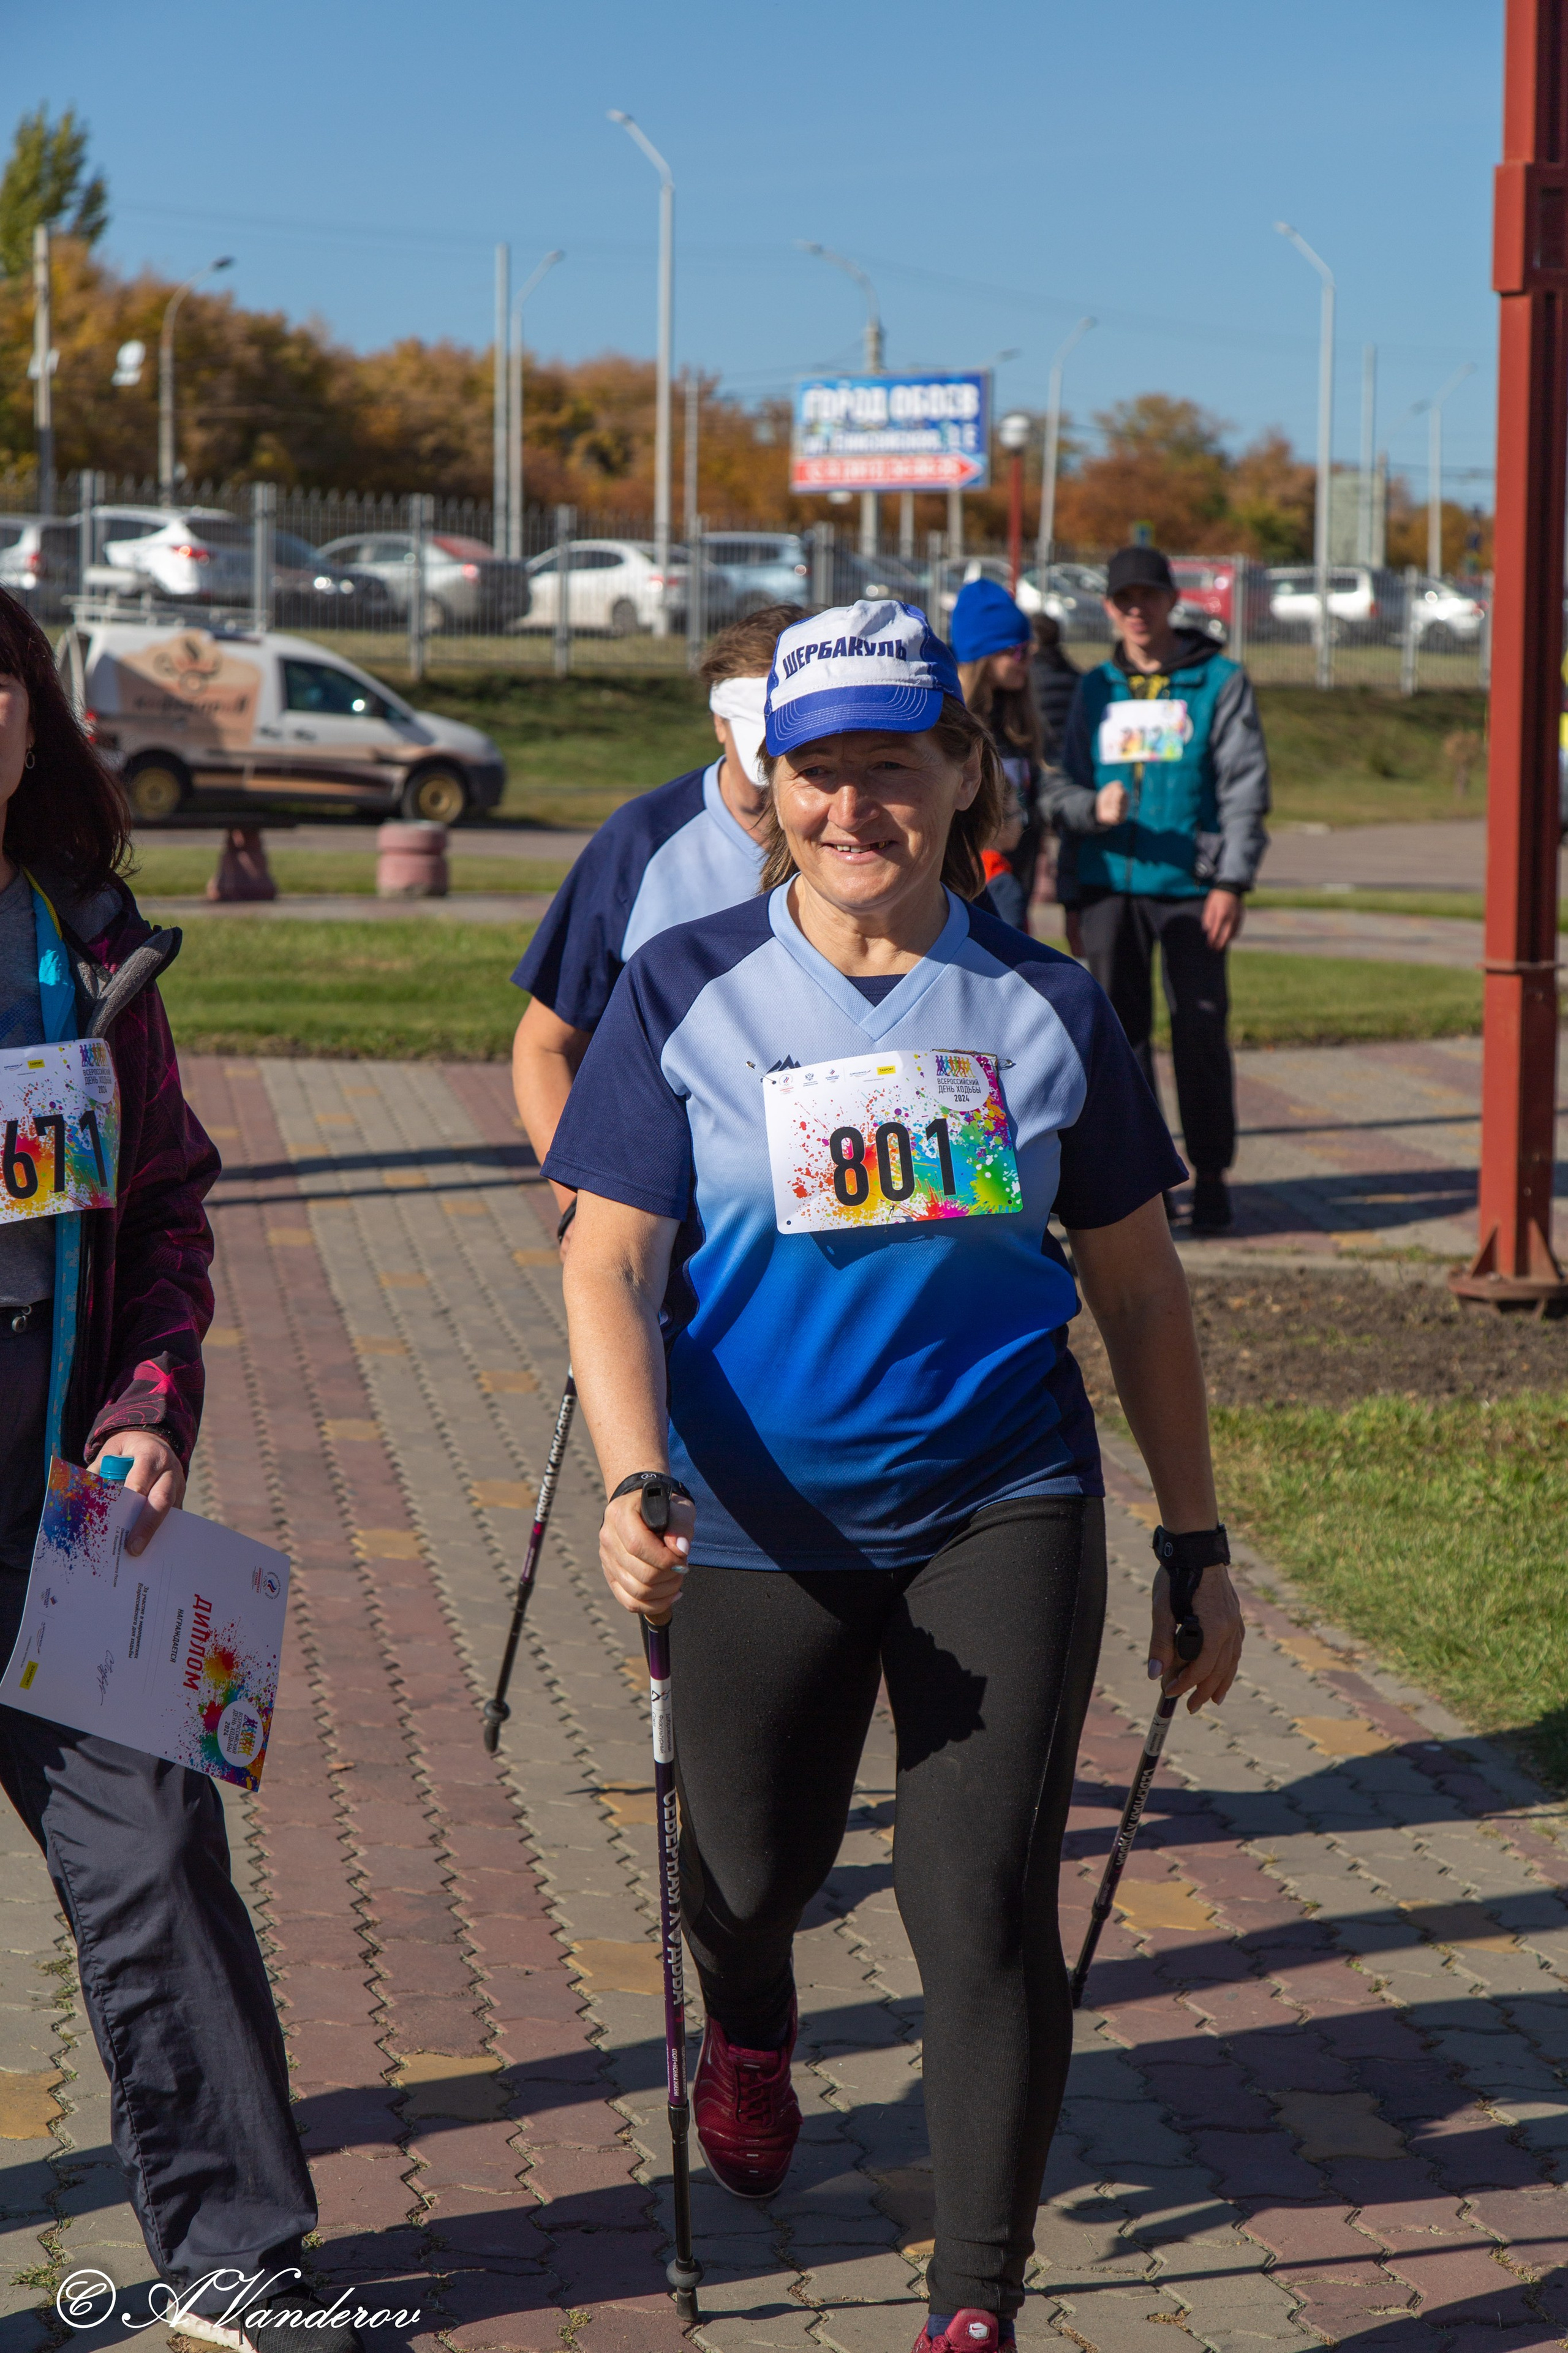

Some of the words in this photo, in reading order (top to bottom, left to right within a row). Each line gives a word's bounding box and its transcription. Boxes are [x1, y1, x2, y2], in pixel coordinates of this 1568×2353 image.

[2, 1110, 108, 1199] 671
[829, 1119, 956, 1206] 801
[133, 1582, 143, 1625] Всероссийского
[134, 1621, 143, 1659] мероприятиях
[170, 1609, 184, 1663] НАГРАЖДАЕТСЯ
[183, 1593, 213, 1691] ДИПЛОМ
[226, 1728, 235, 1753] ХОДЬБЫ
[232, 1712, 243, 1754] ВСЕРОССИЙСКИЙ
